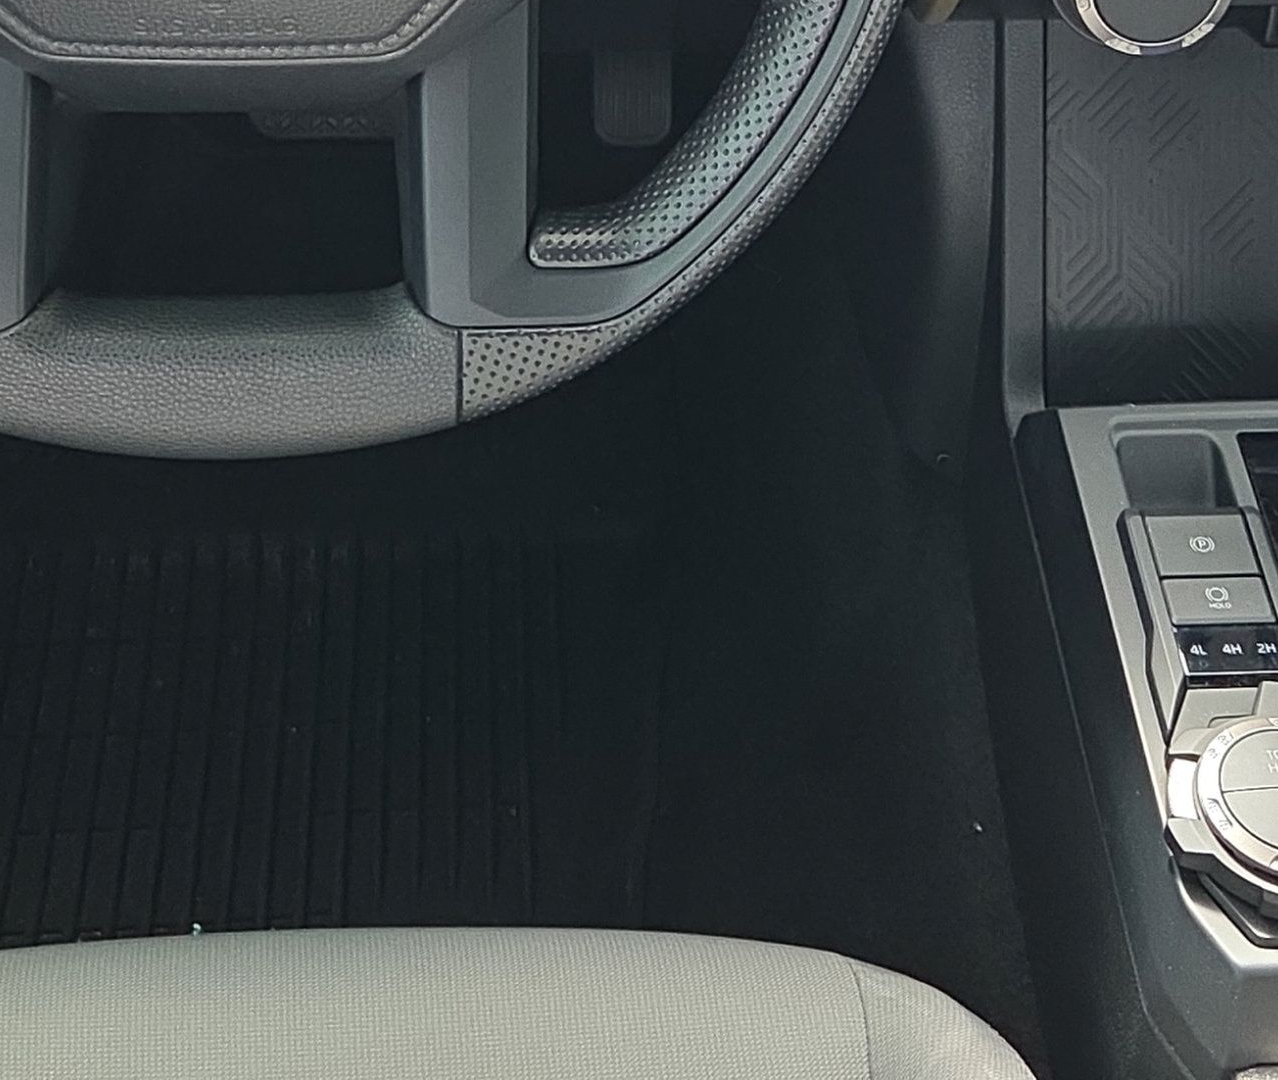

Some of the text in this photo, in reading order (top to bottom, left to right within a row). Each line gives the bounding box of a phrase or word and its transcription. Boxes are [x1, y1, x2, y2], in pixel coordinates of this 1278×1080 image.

[1189, 642, 1277, 656] 4L 4H 2H
